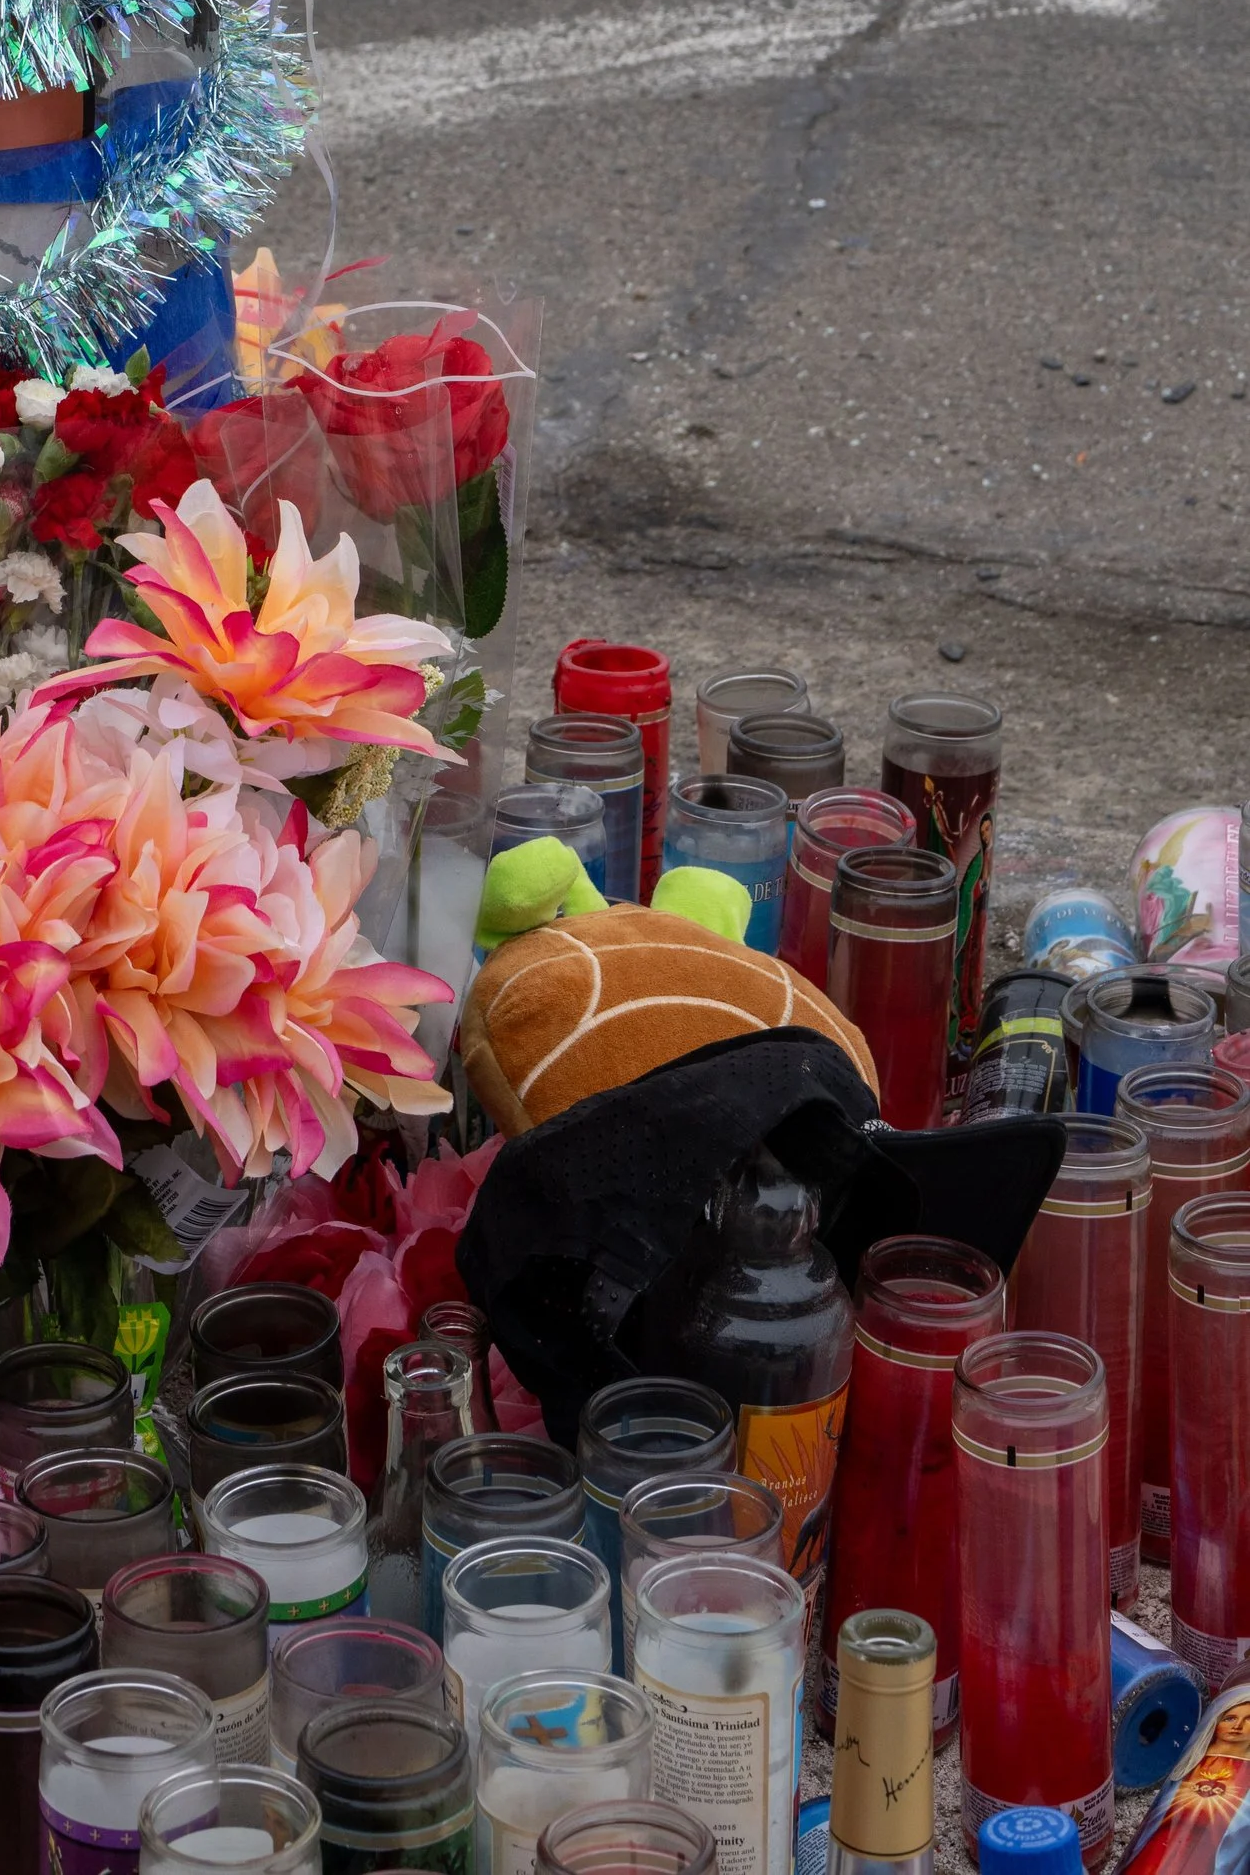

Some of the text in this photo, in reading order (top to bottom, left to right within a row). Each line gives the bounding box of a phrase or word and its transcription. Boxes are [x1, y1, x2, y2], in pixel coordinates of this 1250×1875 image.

[753, 881, 771, 903] DE
[781, 1489, 819, 1510] Jalisco
[215, 1719, 243, 1734] razón
[660, 1708, 710, 1731] Santísima
[712, 1718, 761, 1731] Trinidad
[717, 1734, 746, 1743] presente
[709, 1749, 719, 1757] de
[1076, 1806, 1107, 1833] Stella
[713, 1836, 746, 1847] rinity
